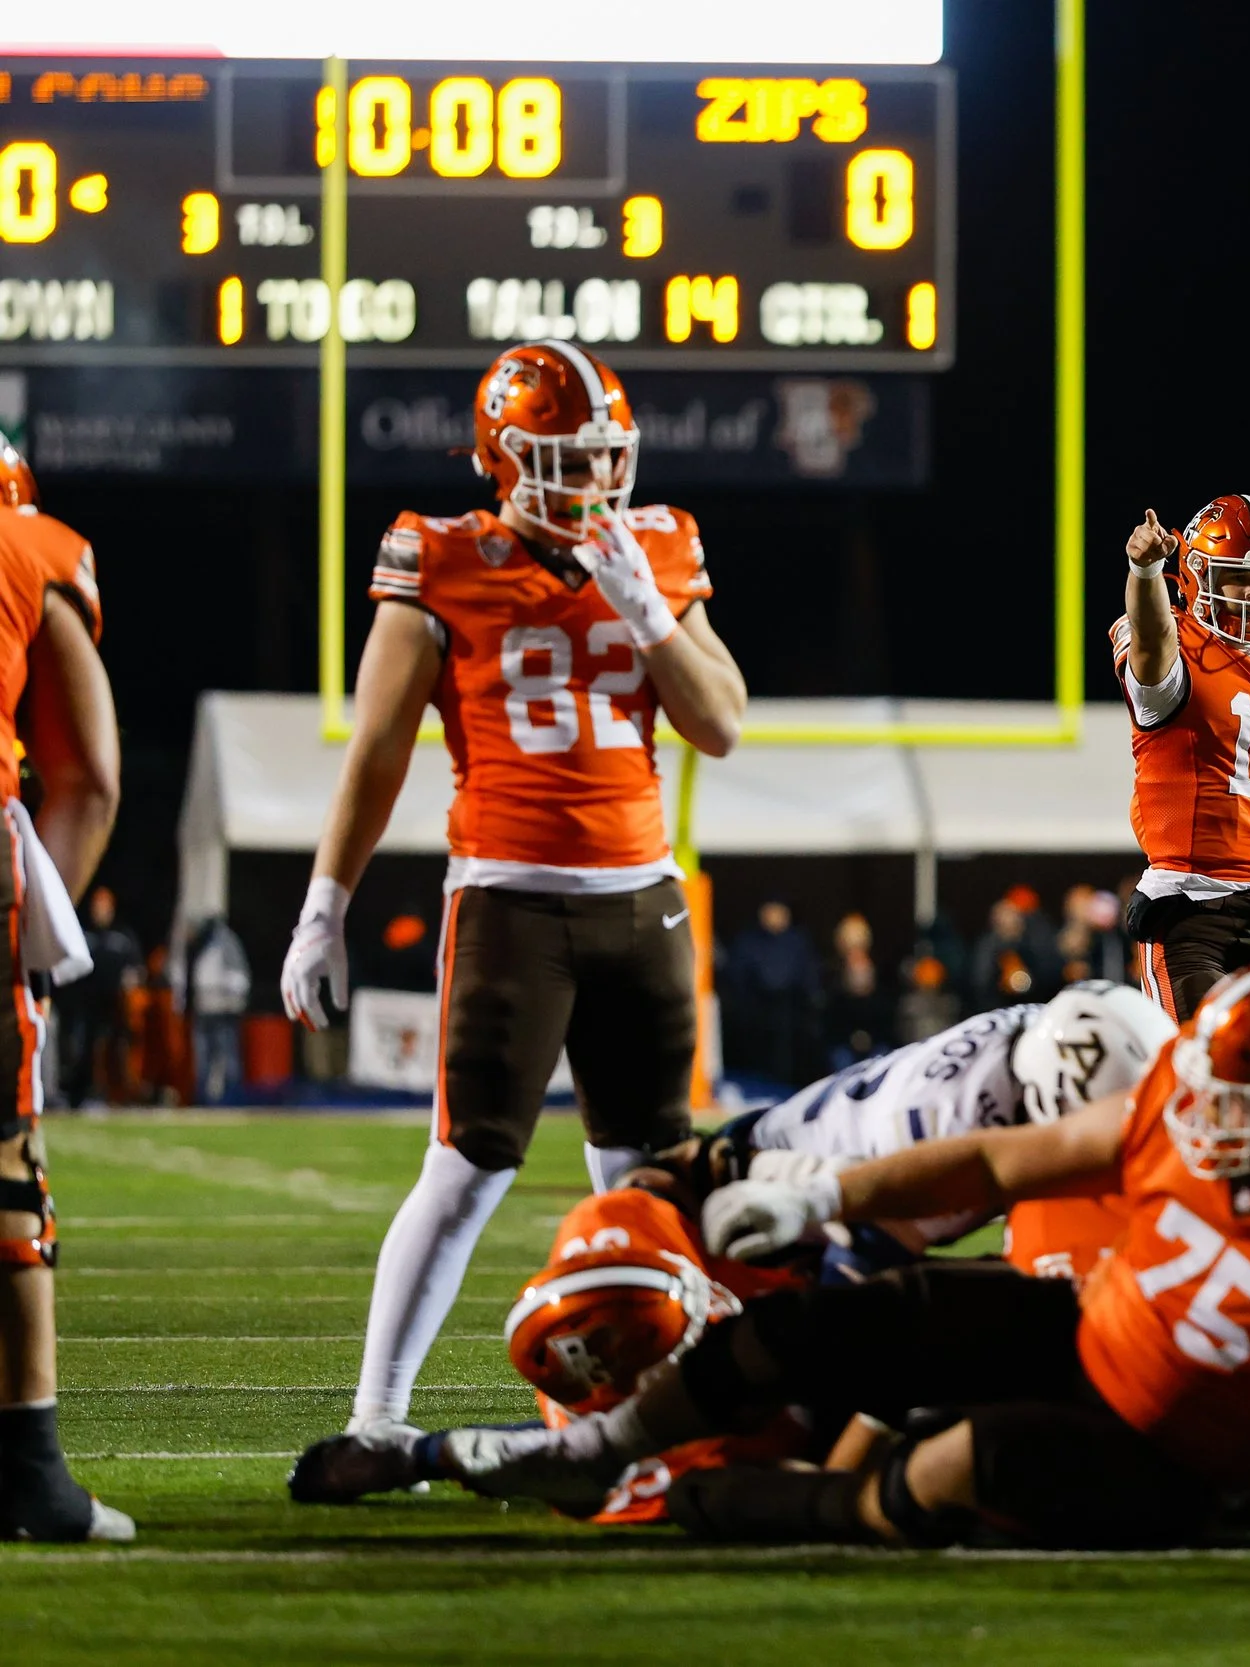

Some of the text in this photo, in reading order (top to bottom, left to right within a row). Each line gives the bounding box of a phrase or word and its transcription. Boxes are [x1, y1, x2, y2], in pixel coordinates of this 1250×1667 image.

[696, 78, 868, 142] ZIPS
[0, 141, 57, 242] 0
[847, 149, 914, 249] 0
[0, 279, 114, 341] OWN
[219, 276, 243, 346] 1
[666, 274, 739, 343] 14
[907, 281, 936, 350] 1
[501, 619, 646, 754] 82
